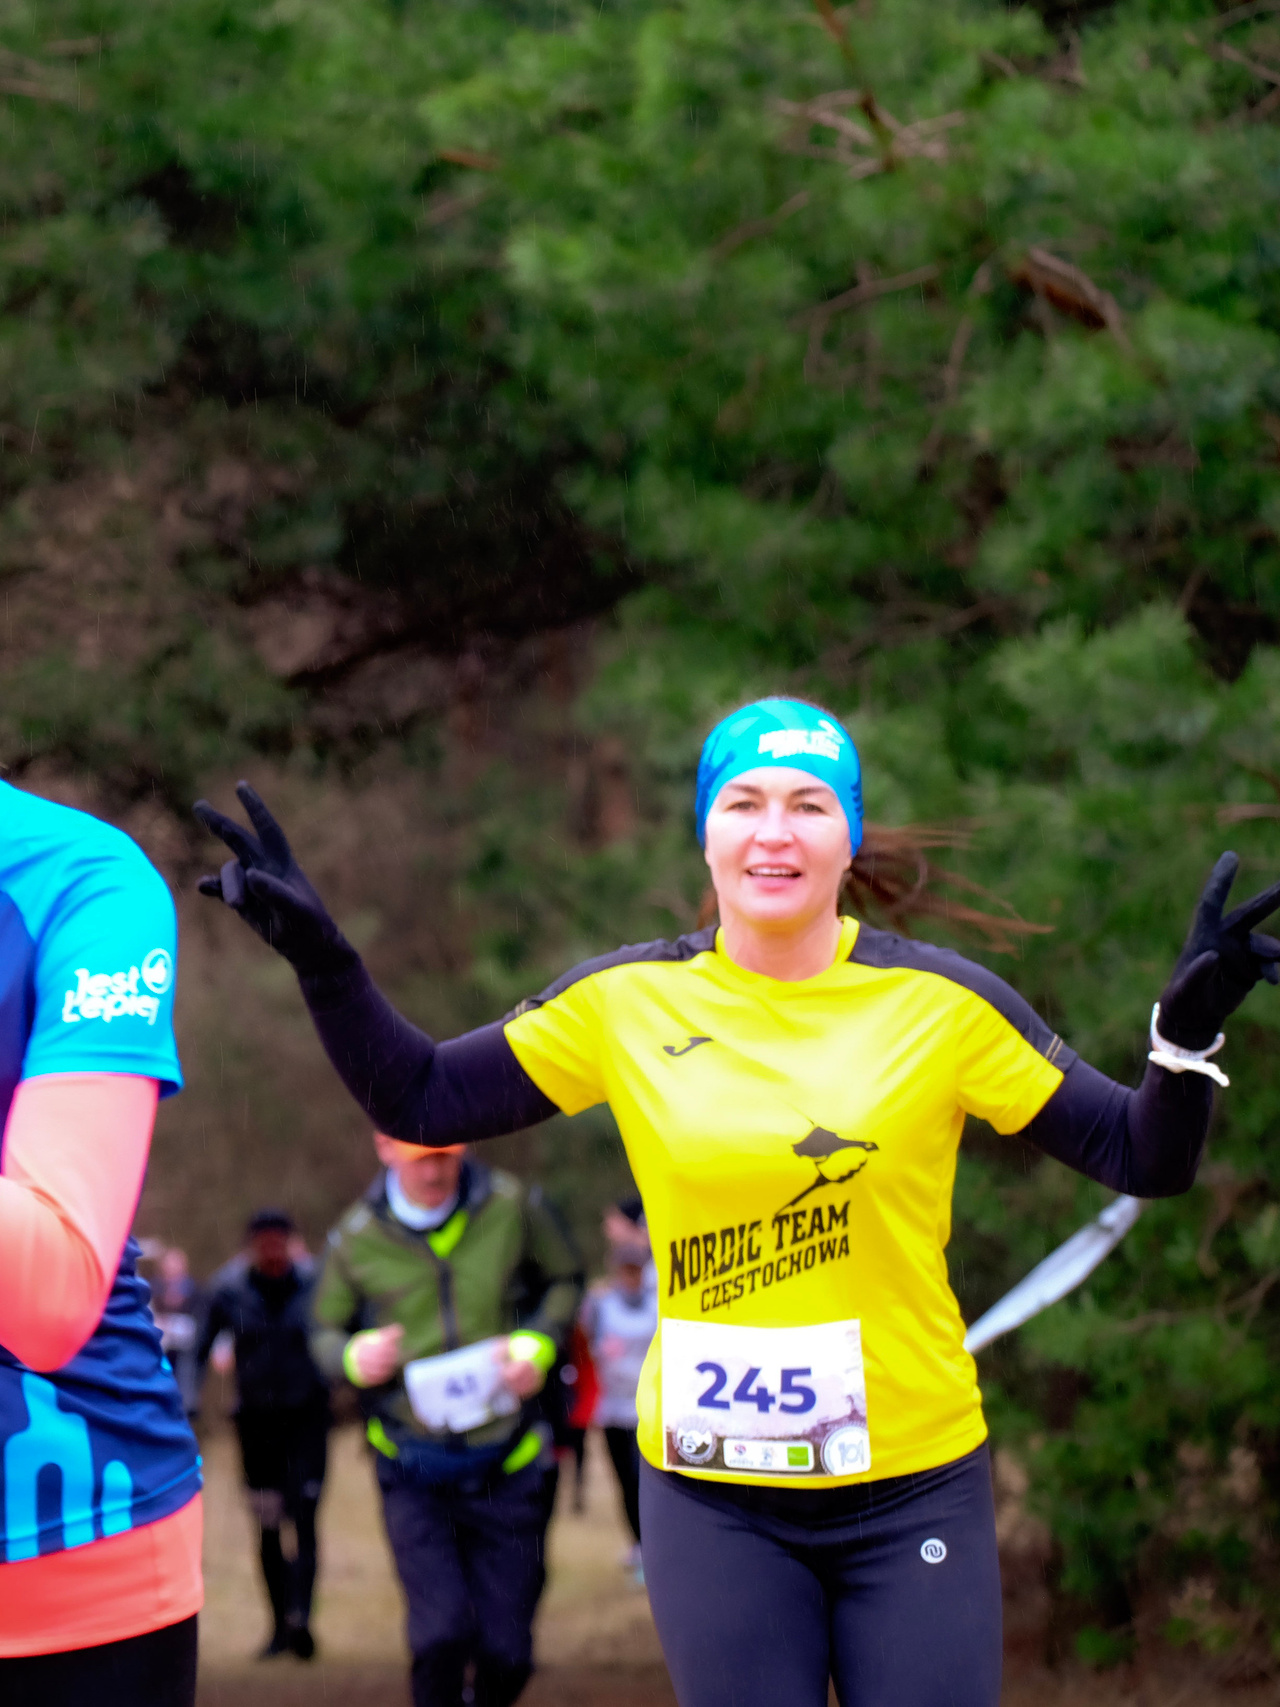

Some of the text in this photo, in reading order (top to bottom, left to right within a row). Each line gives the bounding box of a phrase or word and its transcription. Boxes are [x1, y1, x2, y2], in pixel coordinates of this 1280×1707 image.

[668, 1199, 851, 1299] NORDIC TEAM
[700, 1233, 850, 1314] CZĘSTOCHOWA
[694, 1361, 817, 1415] 245
